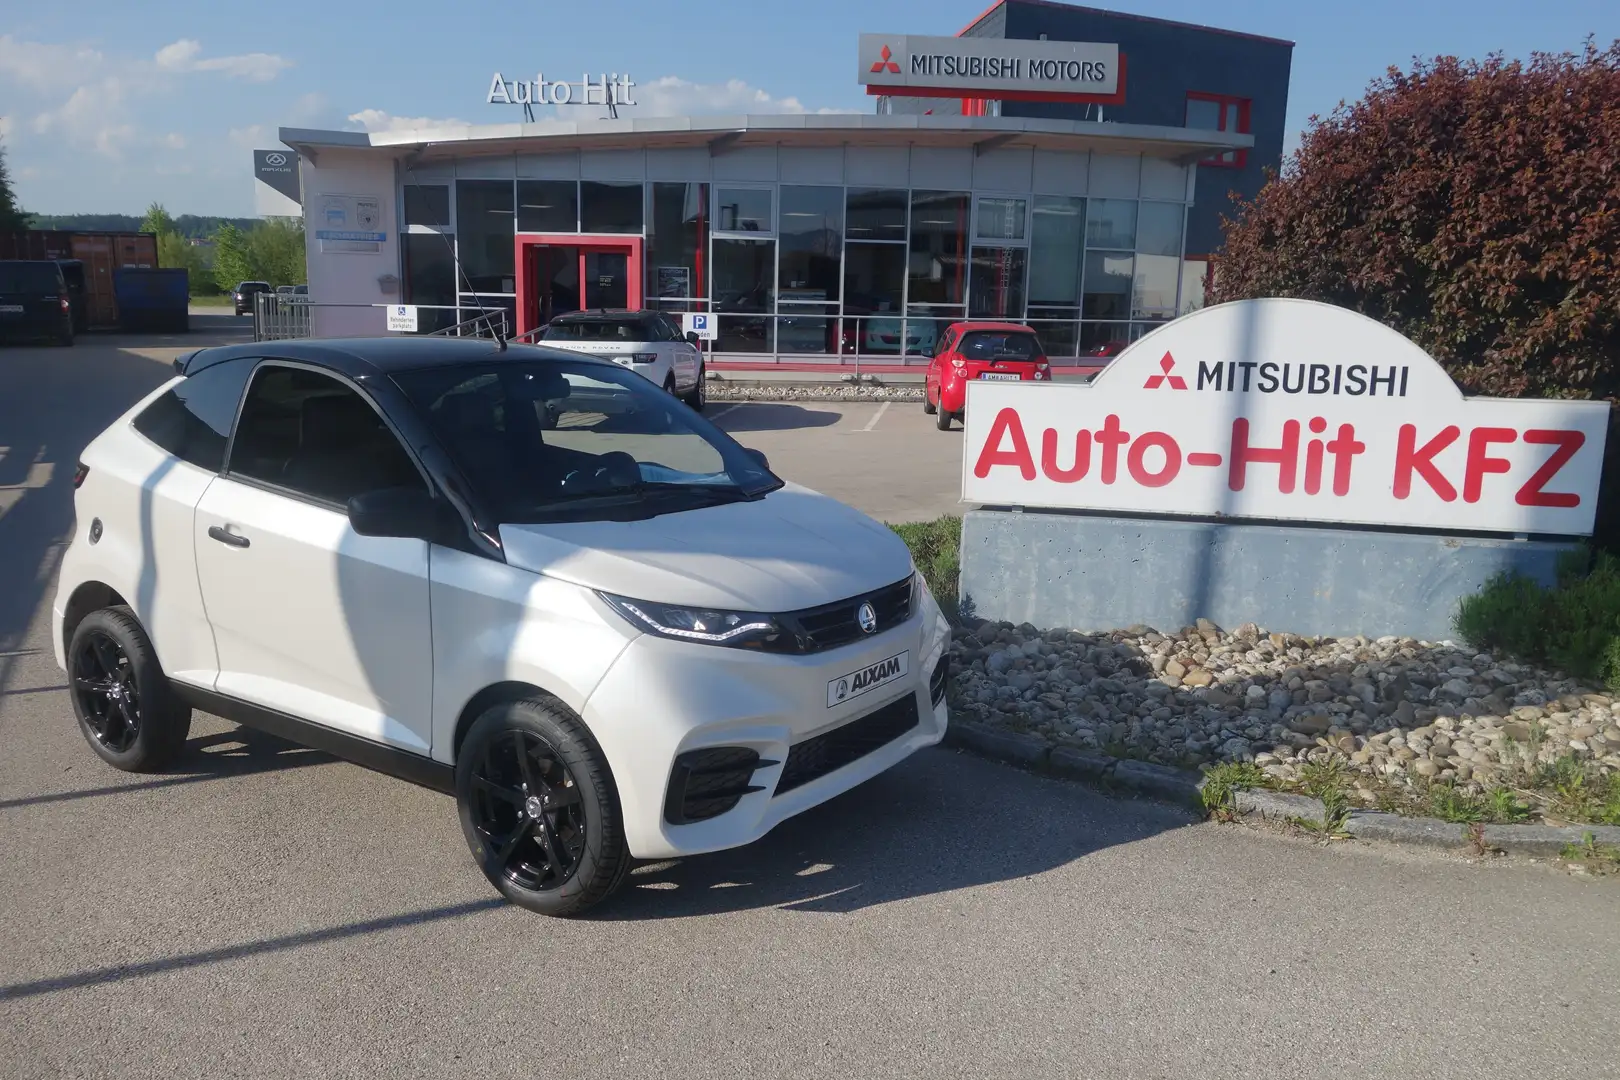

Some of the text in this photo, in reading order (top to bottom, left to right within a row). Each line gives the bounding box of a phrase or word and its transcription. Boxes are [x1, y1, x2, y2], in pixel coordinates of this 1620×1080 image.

[911, 54, 1106, 81] MITSUBISHI MOTORS
[487, 72, 637, 105] Auto Hit
[1197, 361, 1409, 397] MITSUBISHI
[973, 408, 1587, 508] Auto-Hit KFZ
[851, 657, 901, 692] AIXAM
